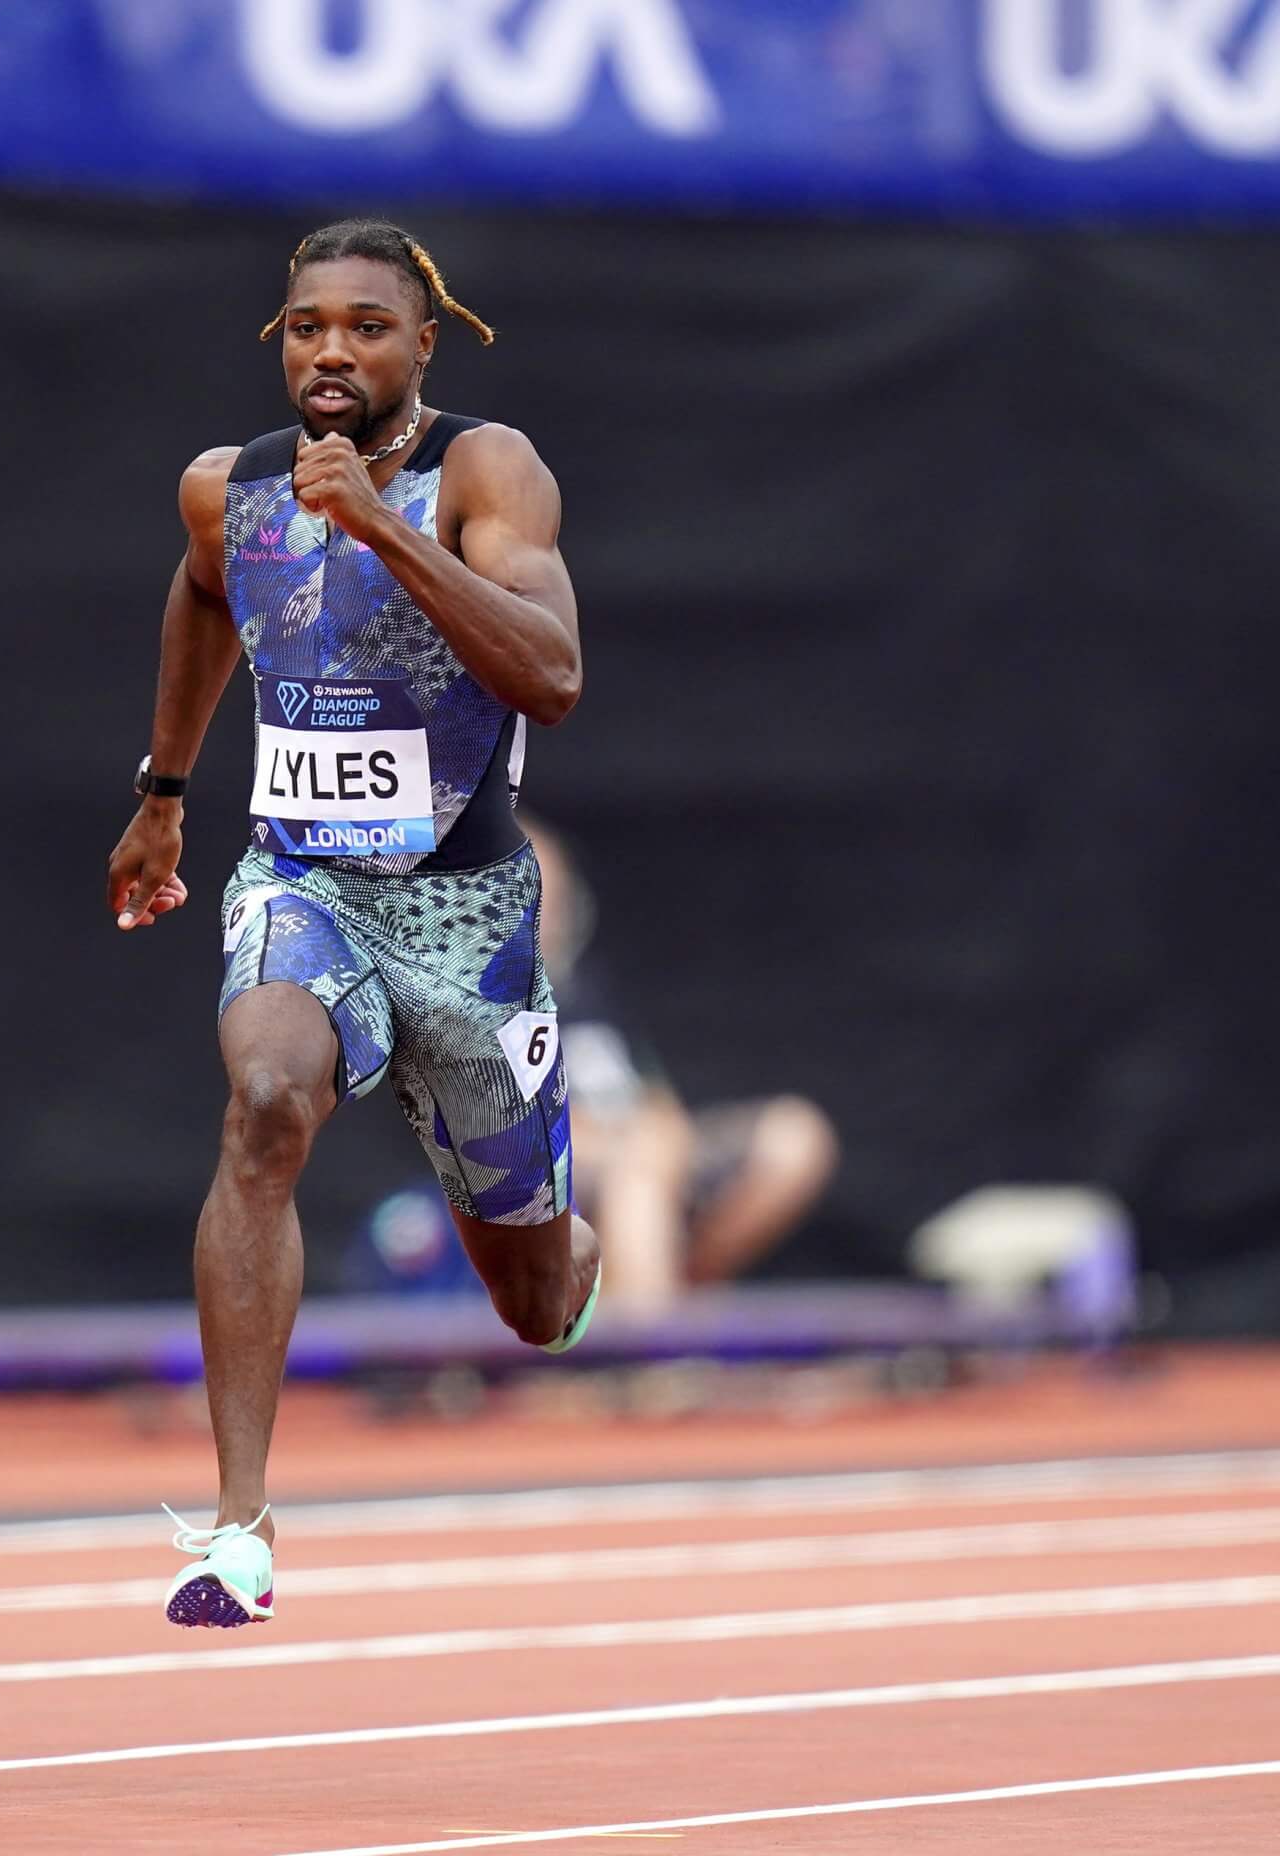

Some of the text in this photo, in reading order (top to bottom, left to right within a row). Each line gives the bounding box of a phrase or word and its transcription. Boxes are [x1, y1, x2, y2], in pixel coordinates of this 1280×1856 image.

[341, 687, 374, 696] WANDA
[312, 698, 381, 712] DIAMOND
[310, 713, 367, 727] LEAGUE
[269, 747, 399, 801] LYLES
[304, 826, 406, 848] LONDON
[229, 897, 247, 931] 6
[527, 1026, 549, 1066] 6
